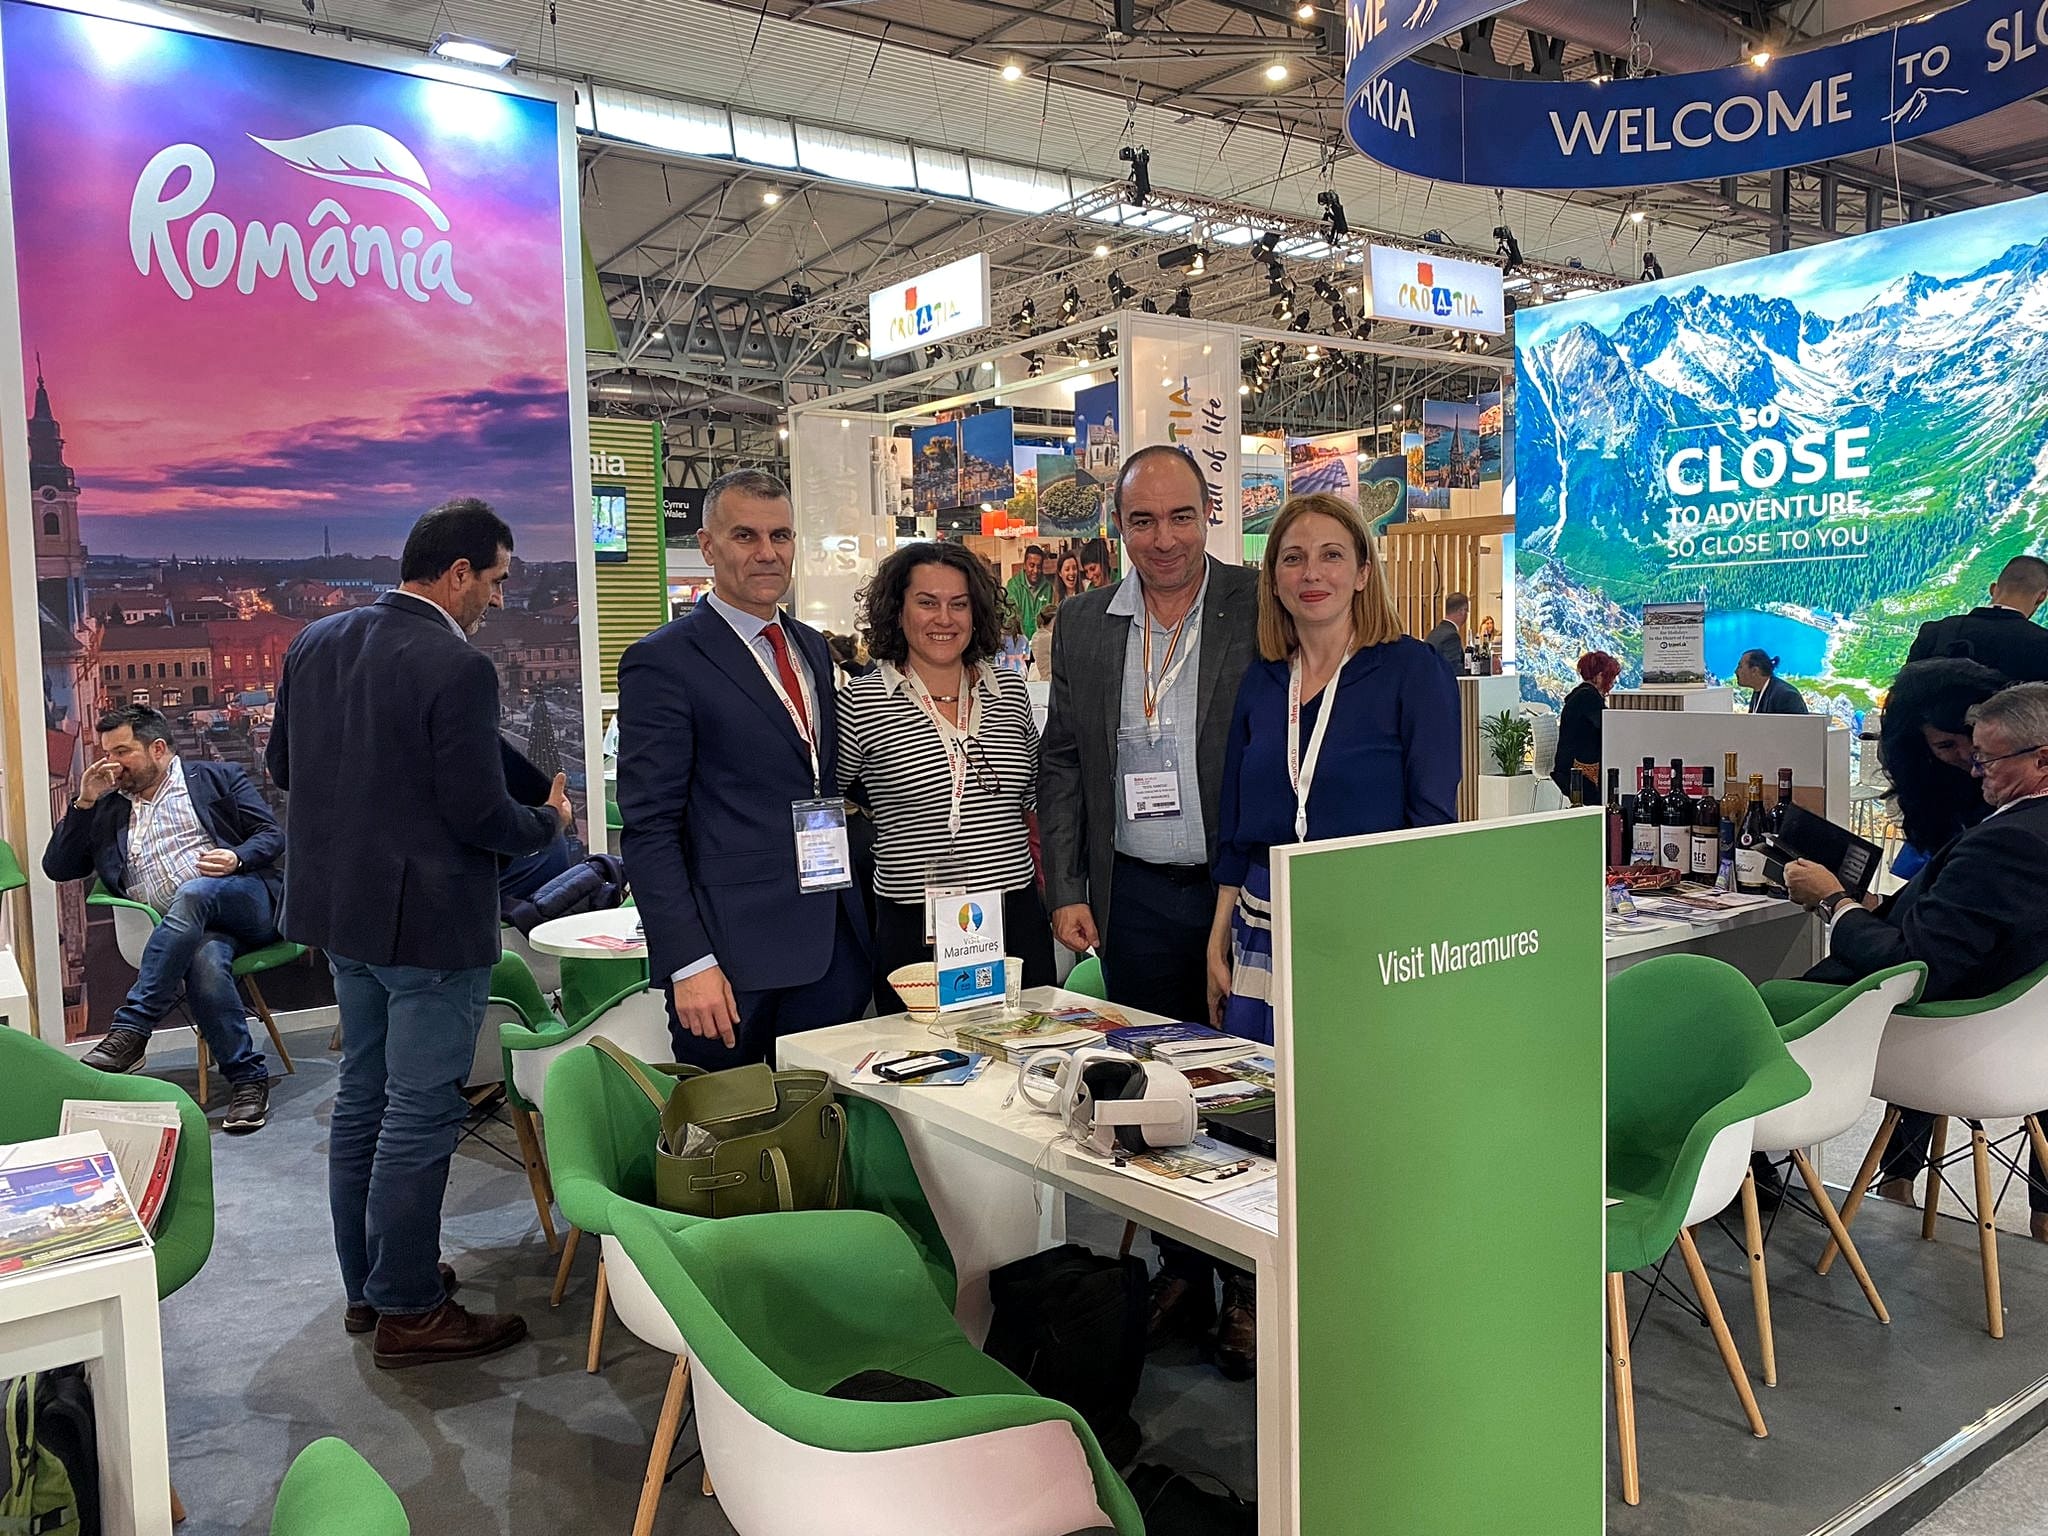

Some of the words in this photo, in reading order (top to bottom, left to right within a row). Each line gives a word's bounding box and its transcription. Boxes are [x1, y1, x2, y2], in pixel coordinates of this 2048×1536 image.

[1549, 72, 1853, 155] WELCOME
[1898, 45, 1950, 84] TO
[1399, 283, 1482, 317] CROATIA
[890, 299, 959, 341] CROATIA
[1201, 396, 1227, 435] life
[1739, 406, 1780, 431] SO
[1202, 445, 1228, 473] of
[1666, 426, 1870, 496] CLOSE
[663, 500, 690, 510] Cymru
[664, 510, 688, 519] Wales
[1666, 505, 1700, 529] TO
[1668, 537, 1695, 558] SO
[1702, 533, 1771, 556] CLOSE
[1778, 530, 1810, 550] TO
[1816, 526, 1869, 548] YOU
[1378, 946, 1425, 986] Visit
[1431, 929, 1539, 976] Maramures
